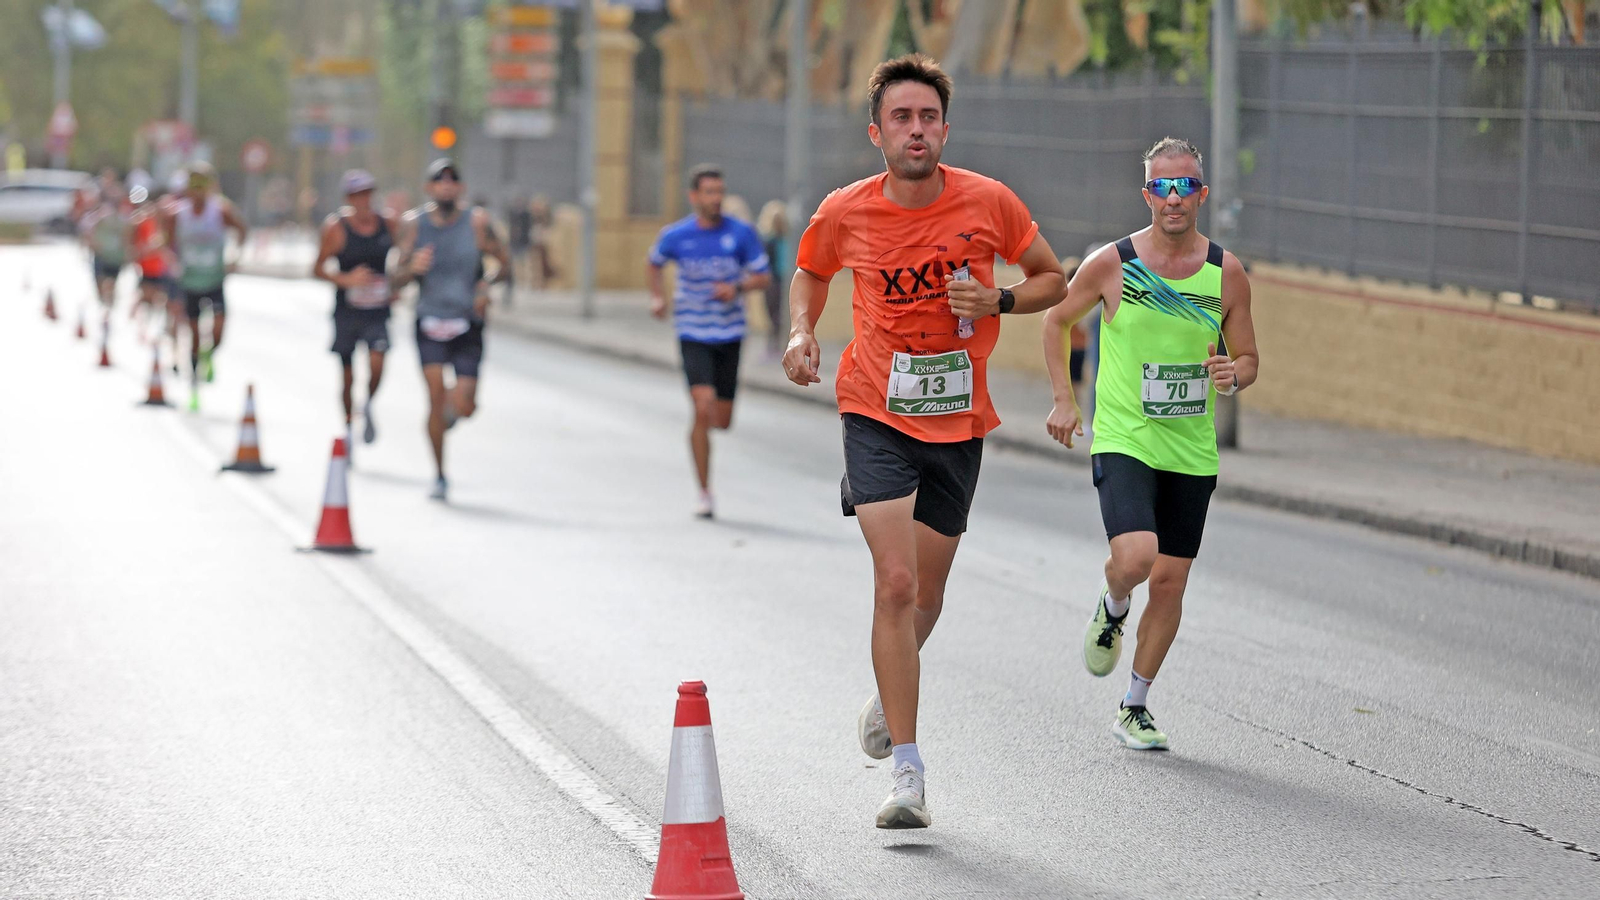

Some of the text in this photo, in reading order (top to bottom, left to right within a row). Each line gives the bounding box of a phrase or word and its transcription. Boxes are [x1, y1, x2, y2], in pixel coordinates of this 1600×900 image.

[916, 291, 948, 302] MARAT
[919, 376, 946, 396] 13
[1166, 382, 1188, 400] 70
